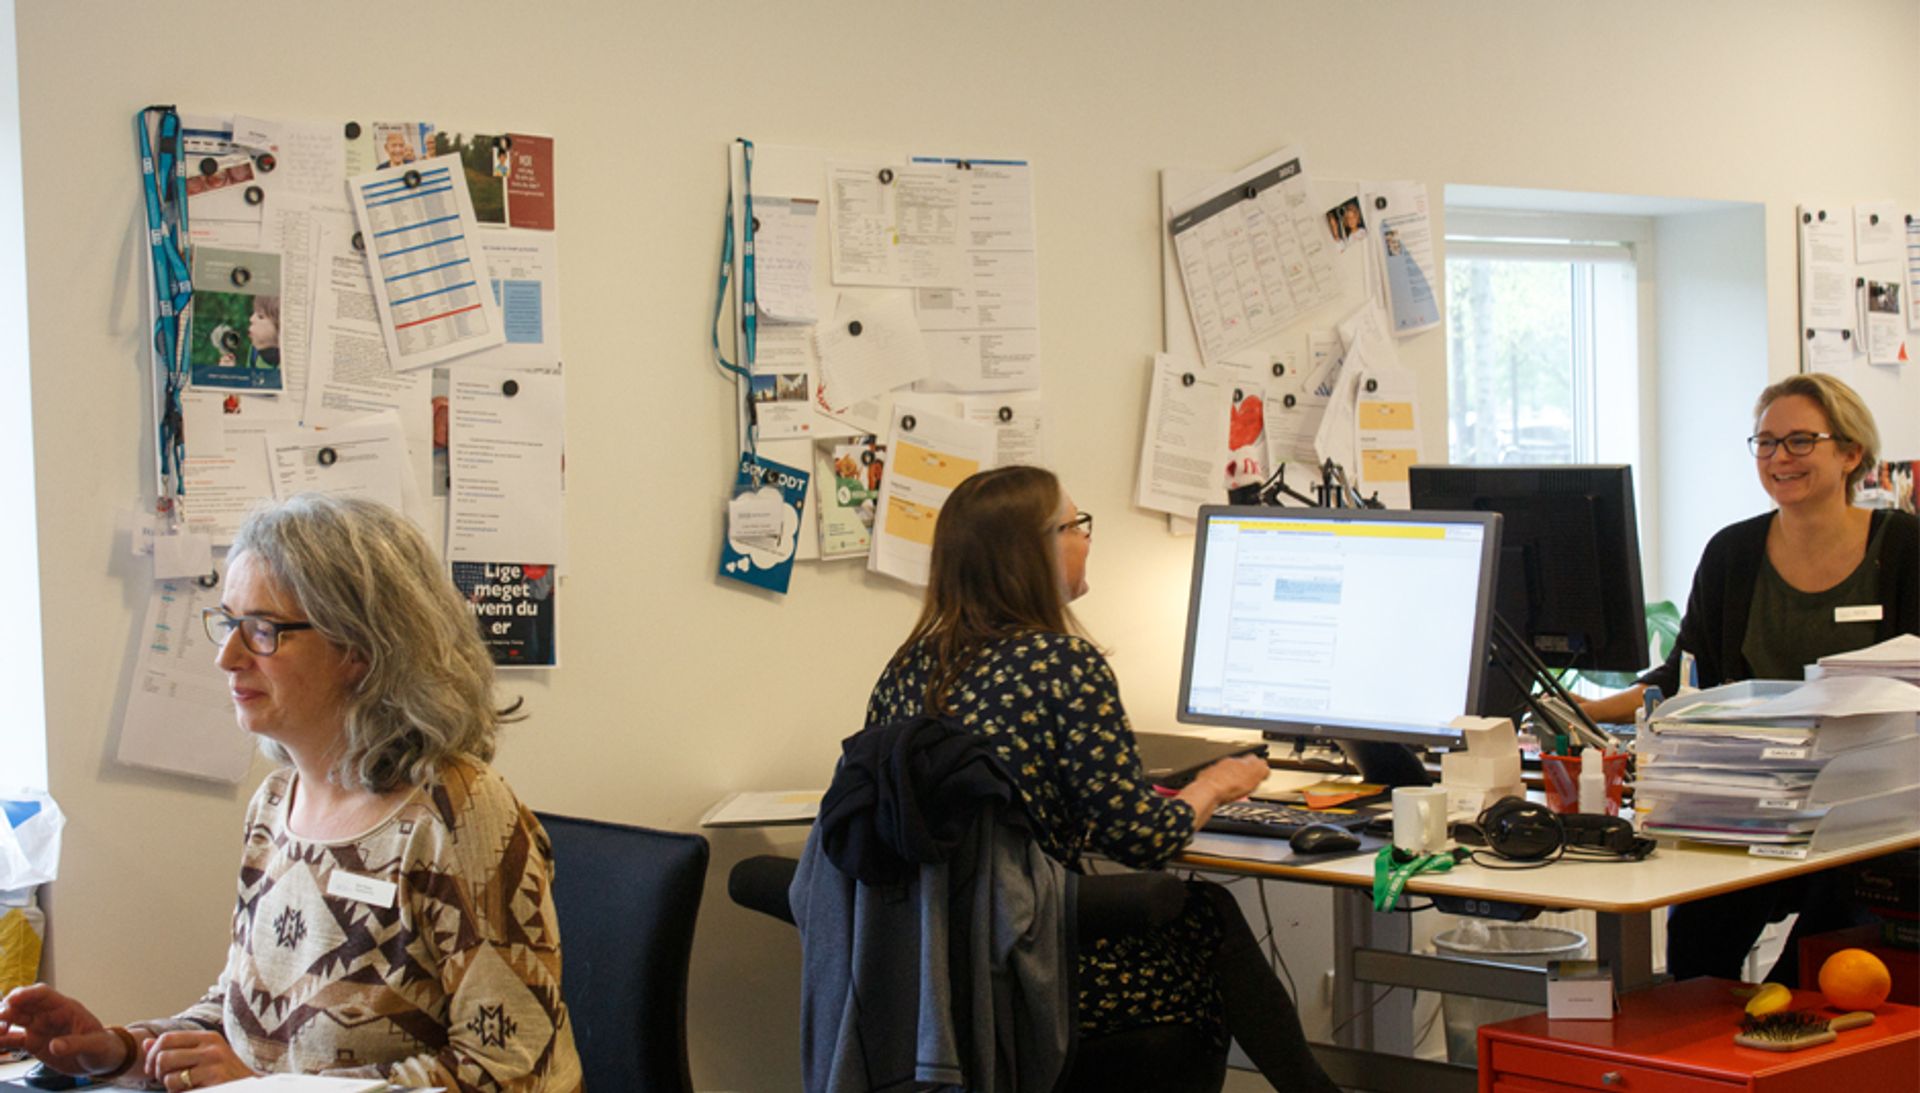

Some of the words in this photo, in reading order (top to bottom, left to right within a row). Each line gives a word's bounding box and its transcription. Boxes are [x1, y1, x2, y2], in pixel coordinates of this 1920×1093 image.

[767, 470, 806, 491] ODT
[484, 563, 520, 583] Lige
[474, 584, 530, 601] meget
[516, 600, 538, 616] du
[492, 621, 512, 634] er
